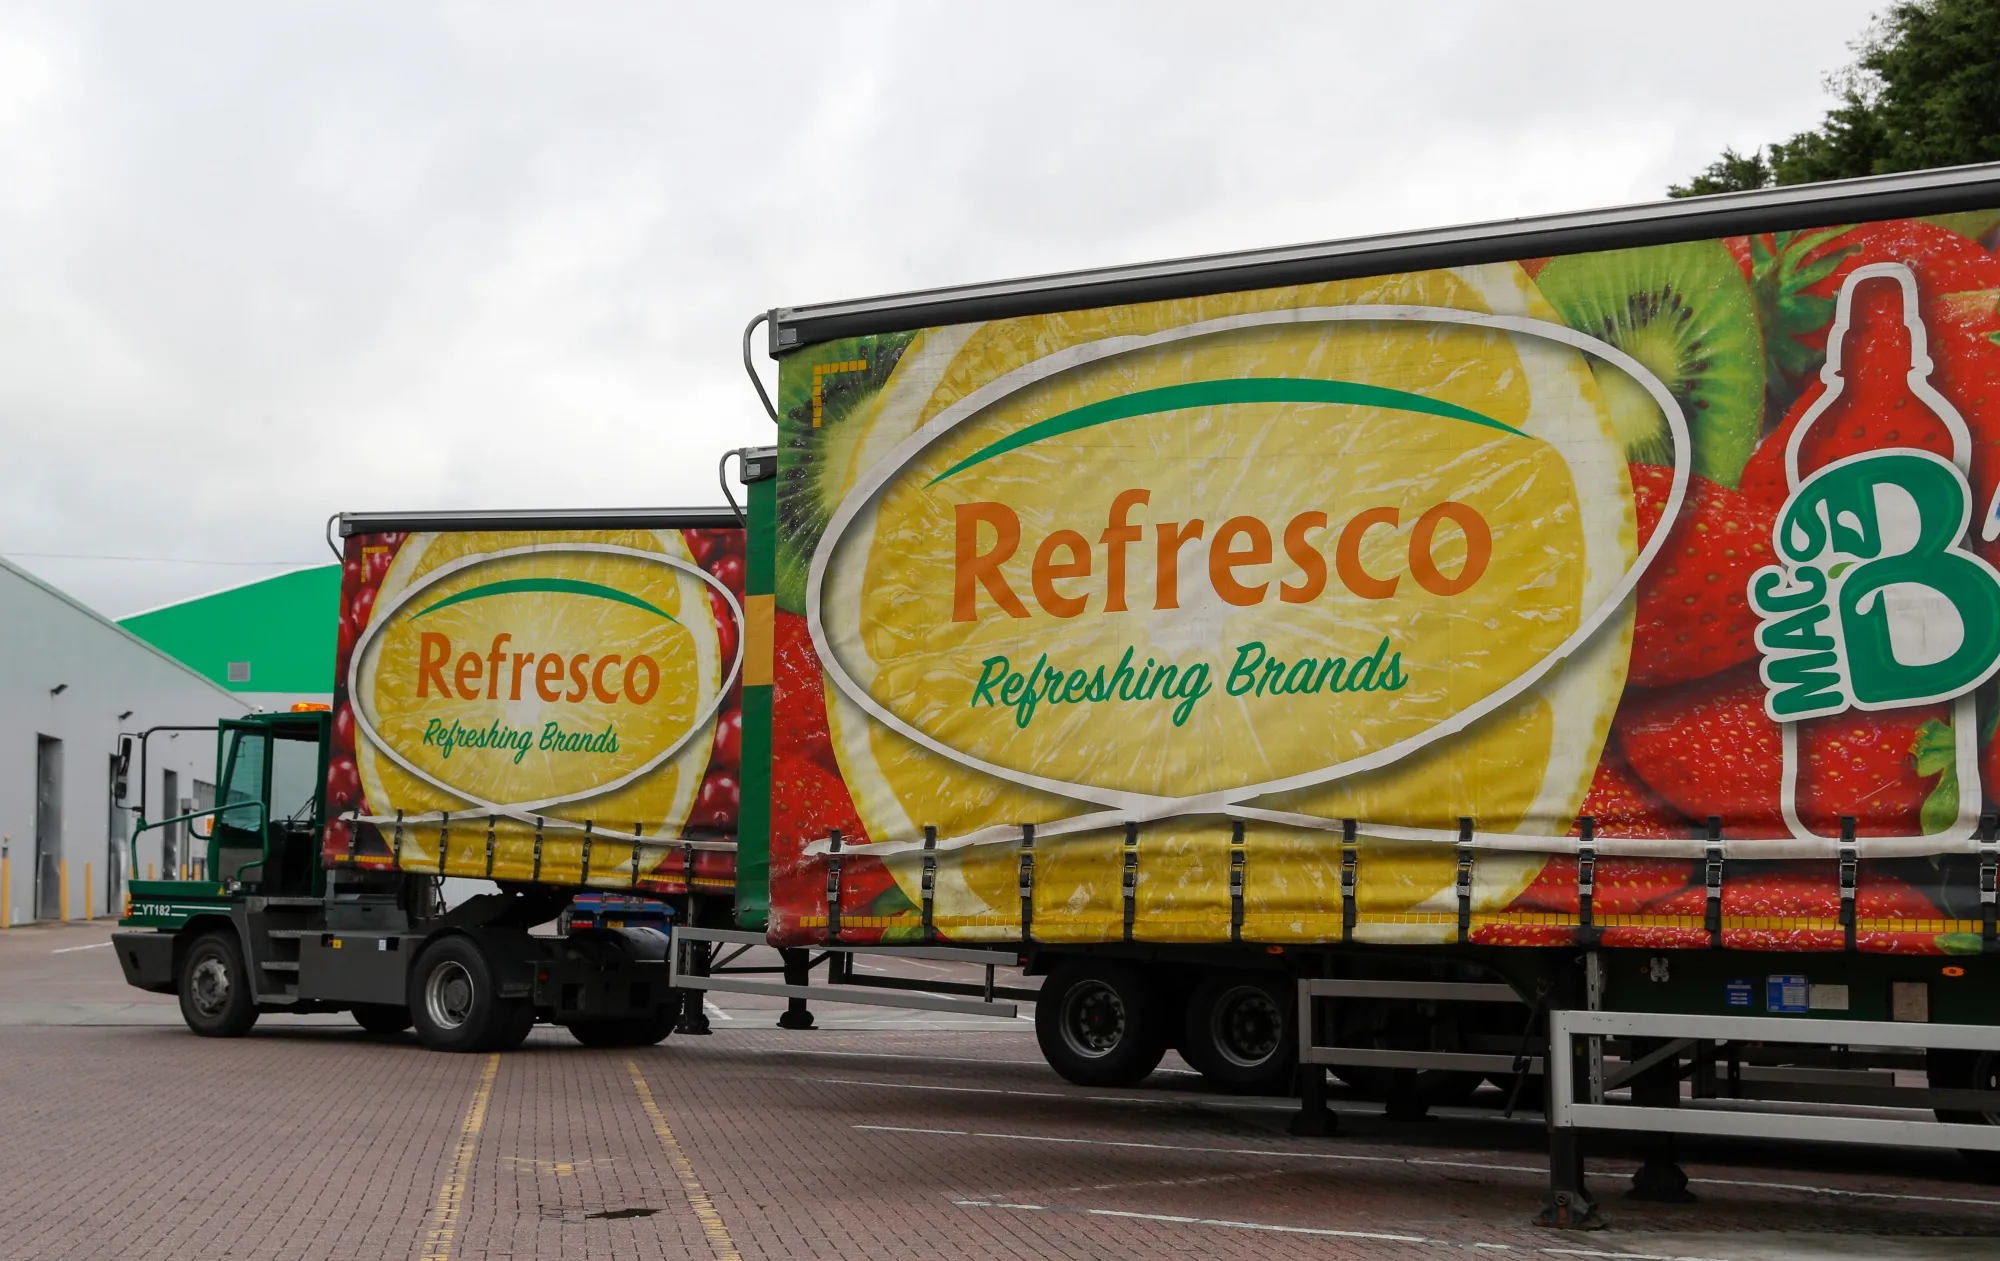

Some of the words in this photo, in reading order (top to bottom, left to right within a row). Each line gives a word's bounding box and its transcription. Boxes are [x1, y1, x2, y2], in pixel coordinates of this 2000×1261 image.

[952, 488, 1491, 623] Refresco
[416, 631, 660, 705] Refresco
[971, 646, 1211, 729] Refreshing
[1227, 637, 1408, 698] Brands
[423, 718, 533, 764] Refreshing
[539, 721, 619, 755] Brands
[142, 903, 171, 917] YT182
